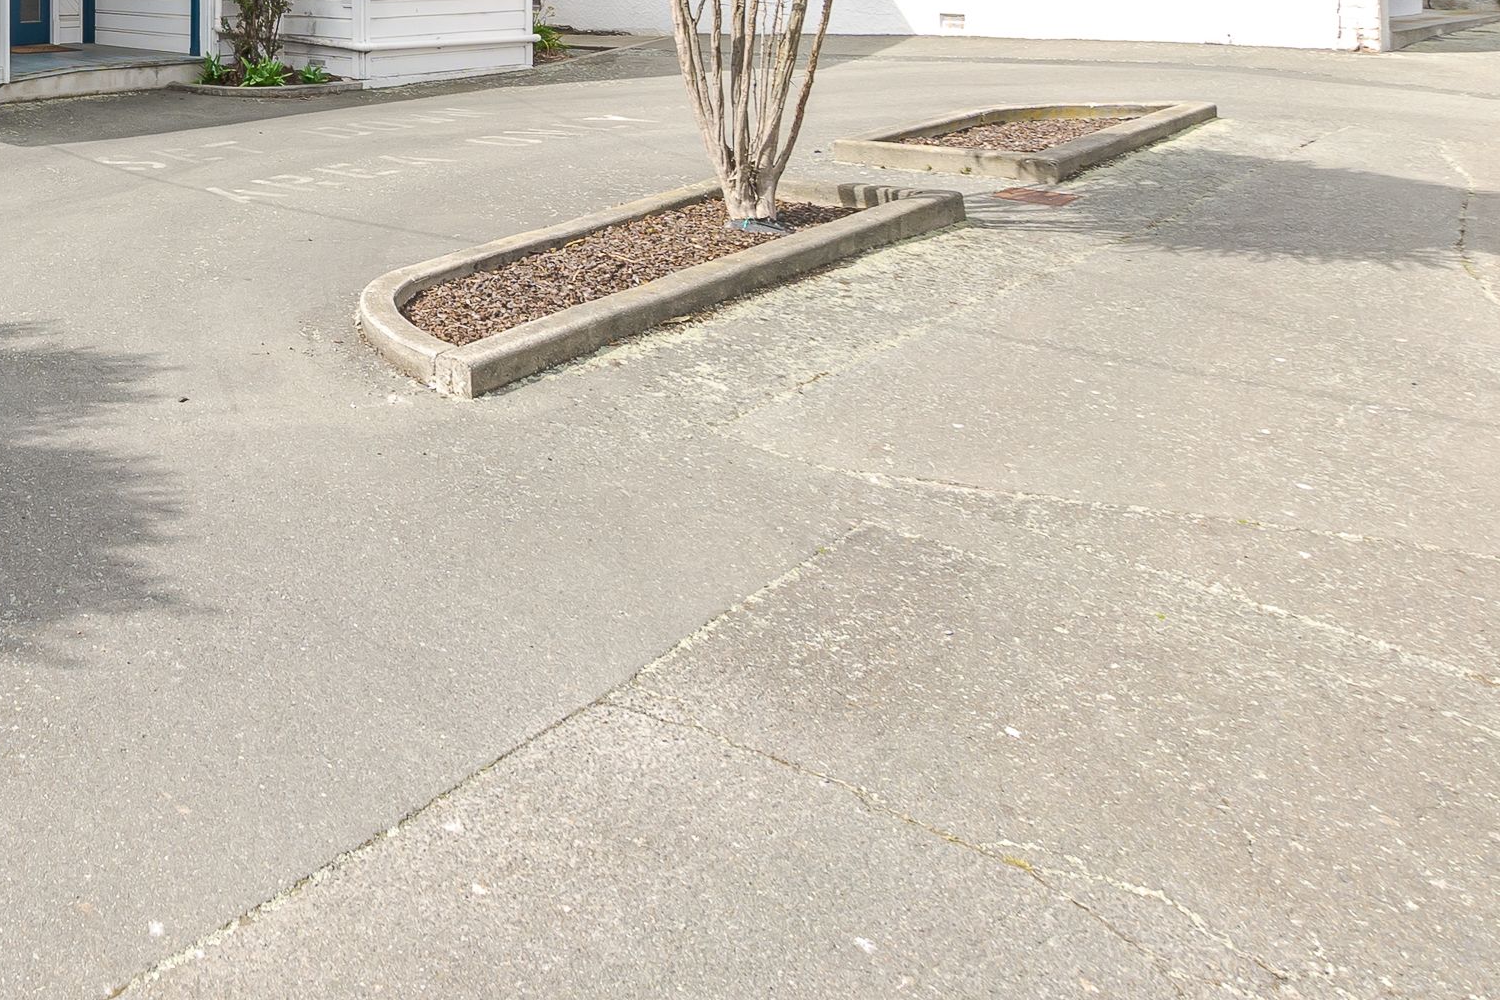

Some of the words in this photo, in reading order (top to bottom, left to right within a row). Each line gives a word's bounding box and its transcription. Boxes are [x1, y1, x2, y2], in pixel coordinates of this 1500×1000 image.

[93, 141, 265, 171] SET
[302, 107, 495, 139] DOWN
[204, 154, 461, 204] AREA
